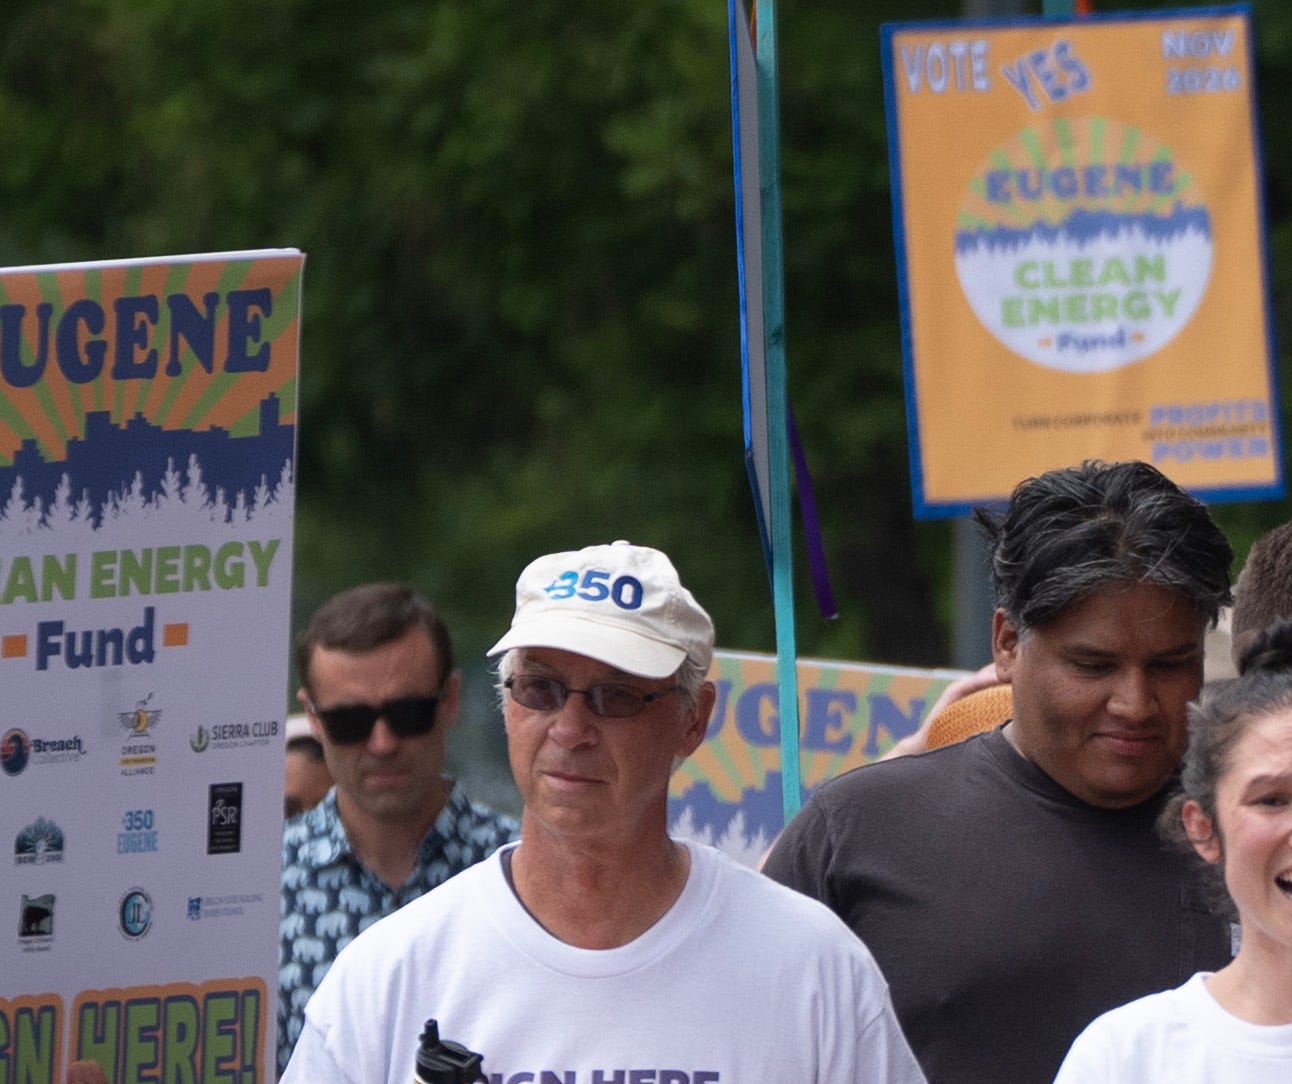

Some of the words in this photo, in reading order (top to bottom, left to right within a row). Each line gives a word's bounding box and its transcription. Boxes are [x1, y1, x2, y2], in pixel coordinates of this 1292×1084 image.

[1161, 29, 1238, 59] NOV
[902, 39, 991, 95] VOTE
[1001, 39, 1092, 113] YES
[1165, 66, 1241, 96] 2026
[984, 159, 1176, 204] EUGENE
[1013, 253, 1167, 291] CLEAN
[1001, 288, 1183, 328] ENERGY
[0, 288, 272, 387] UGENE
[1055, 325, 1127, 353] Fund
[1150, 400, 1267, 425] PROFITS
[1152, 437, 1268, 464] POWER
[90, 539, 281, 599] ENERGY
[544, 570, 644, 611] 350
[36, 606, 155, 670] Fund
[31, 735, 87, 755] Breach
[211, 724, 249, 741] SIERRA
[252, 721, 278, 738] CLUB
[121, 744, 156, 756] OREGON
[124, 810, 154, 831] 350
[212, 804, 237, 825] PSR
[117, 831, 158, 854] EUGENE
